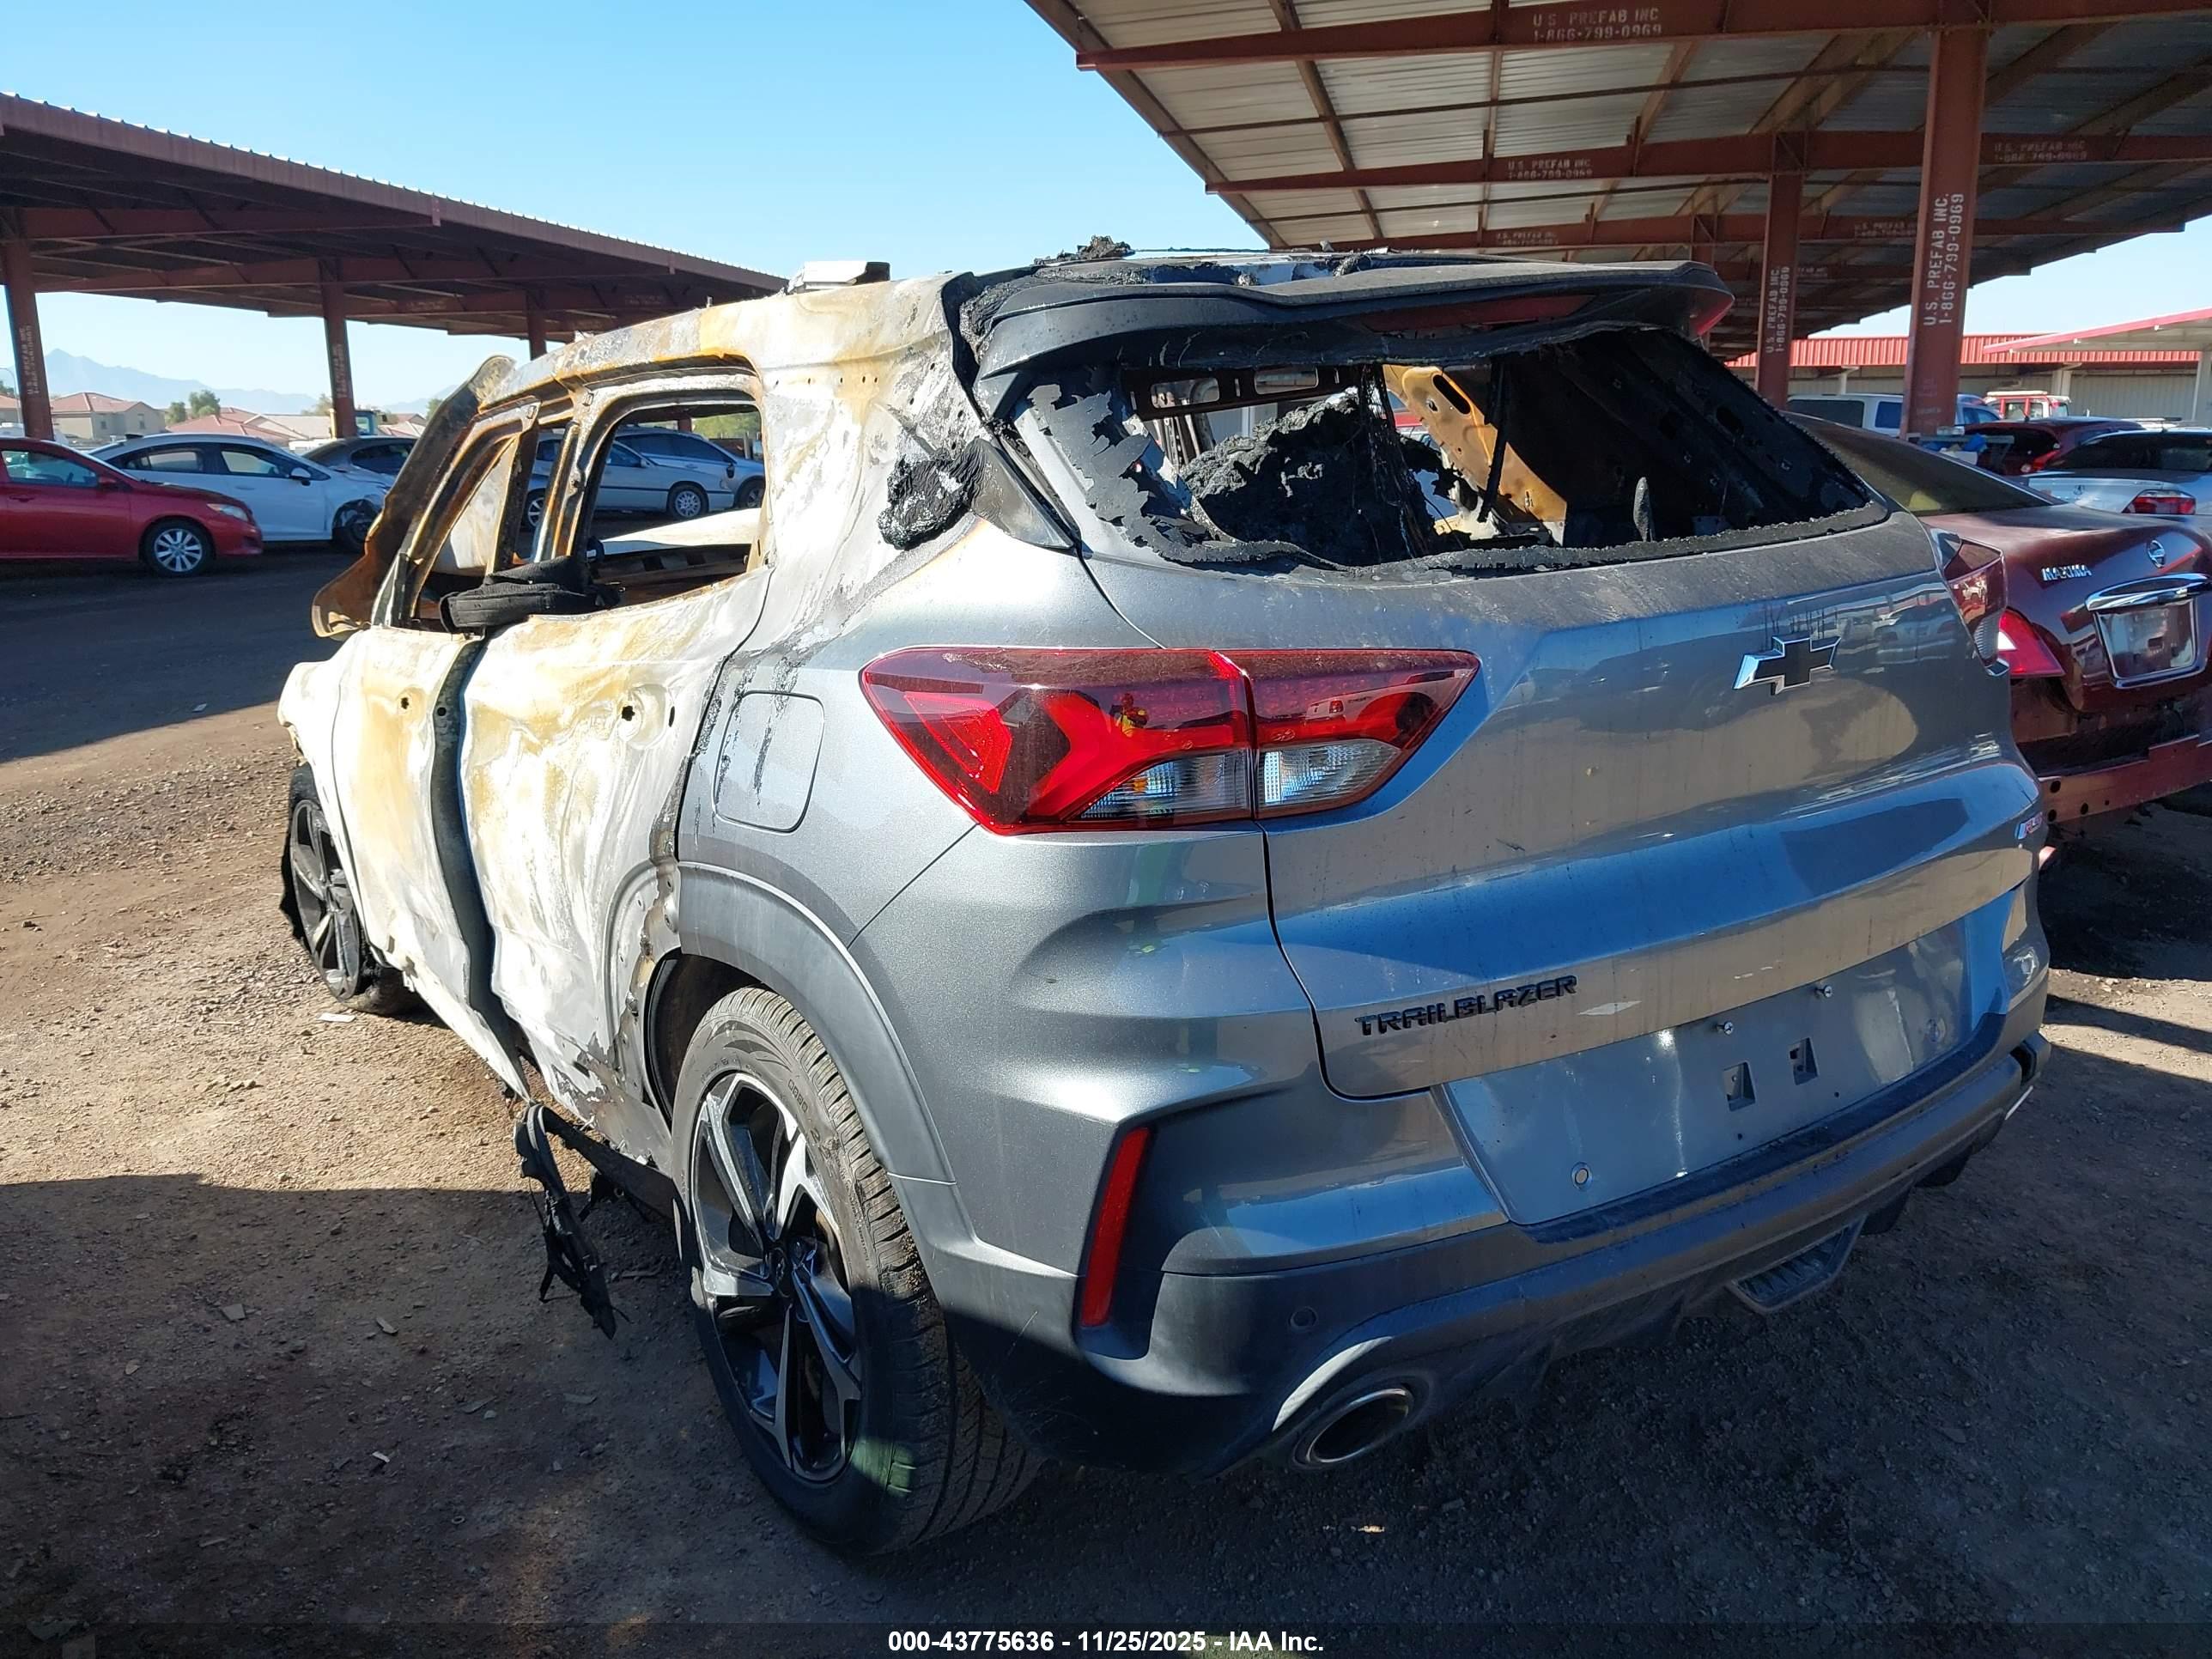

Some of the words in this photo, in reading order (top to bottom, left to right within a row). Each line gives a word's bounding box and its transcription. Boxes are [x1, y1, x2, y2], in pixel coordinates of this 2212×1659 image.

[1570, 9, 1628, 25] PREFAB
[1934, 194, 1949, 222] INC.
[1927, 230, 1945, 289] PREFAB
[1939, 193, 1965, 323] 1-866-799-0969
[1767, 289, 1778, 329] PREFAB
[1923, 297, 1940, 325] U.S.
[2041, 563, 2093, 581] MAXIMA
[1354, 975, 1577, 1036] TRAILBLAZER
